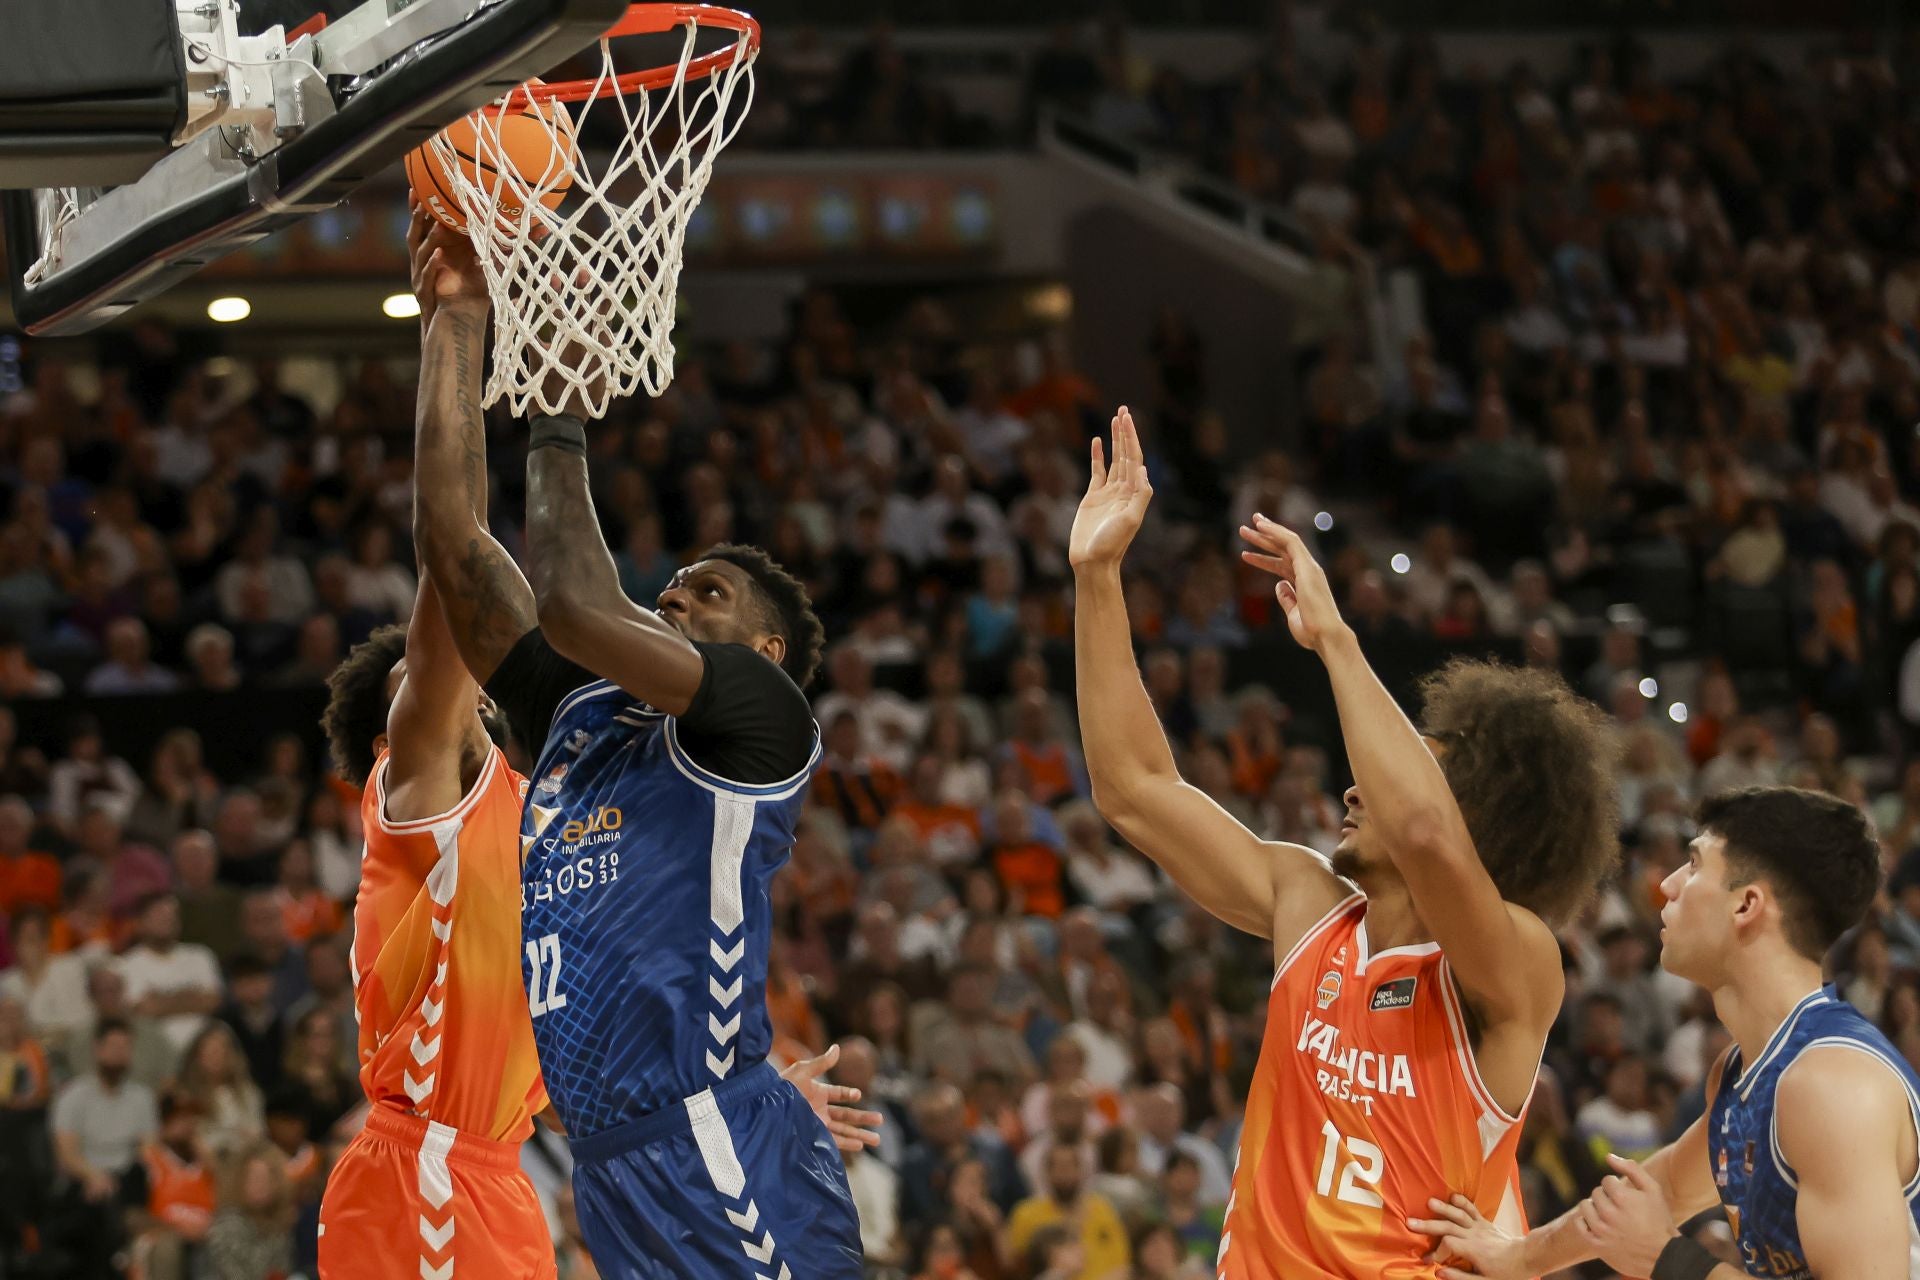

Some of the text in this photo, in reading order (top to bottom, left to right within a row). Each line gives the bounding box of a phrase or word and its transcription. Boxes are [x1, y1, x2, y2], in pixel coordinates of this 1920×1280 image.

[1297, 1011, 1416, 1097] VALNCIA
[1316, 1068, 1375, 1117] BAST
[1316, 1119, 1385, 1209] 12
